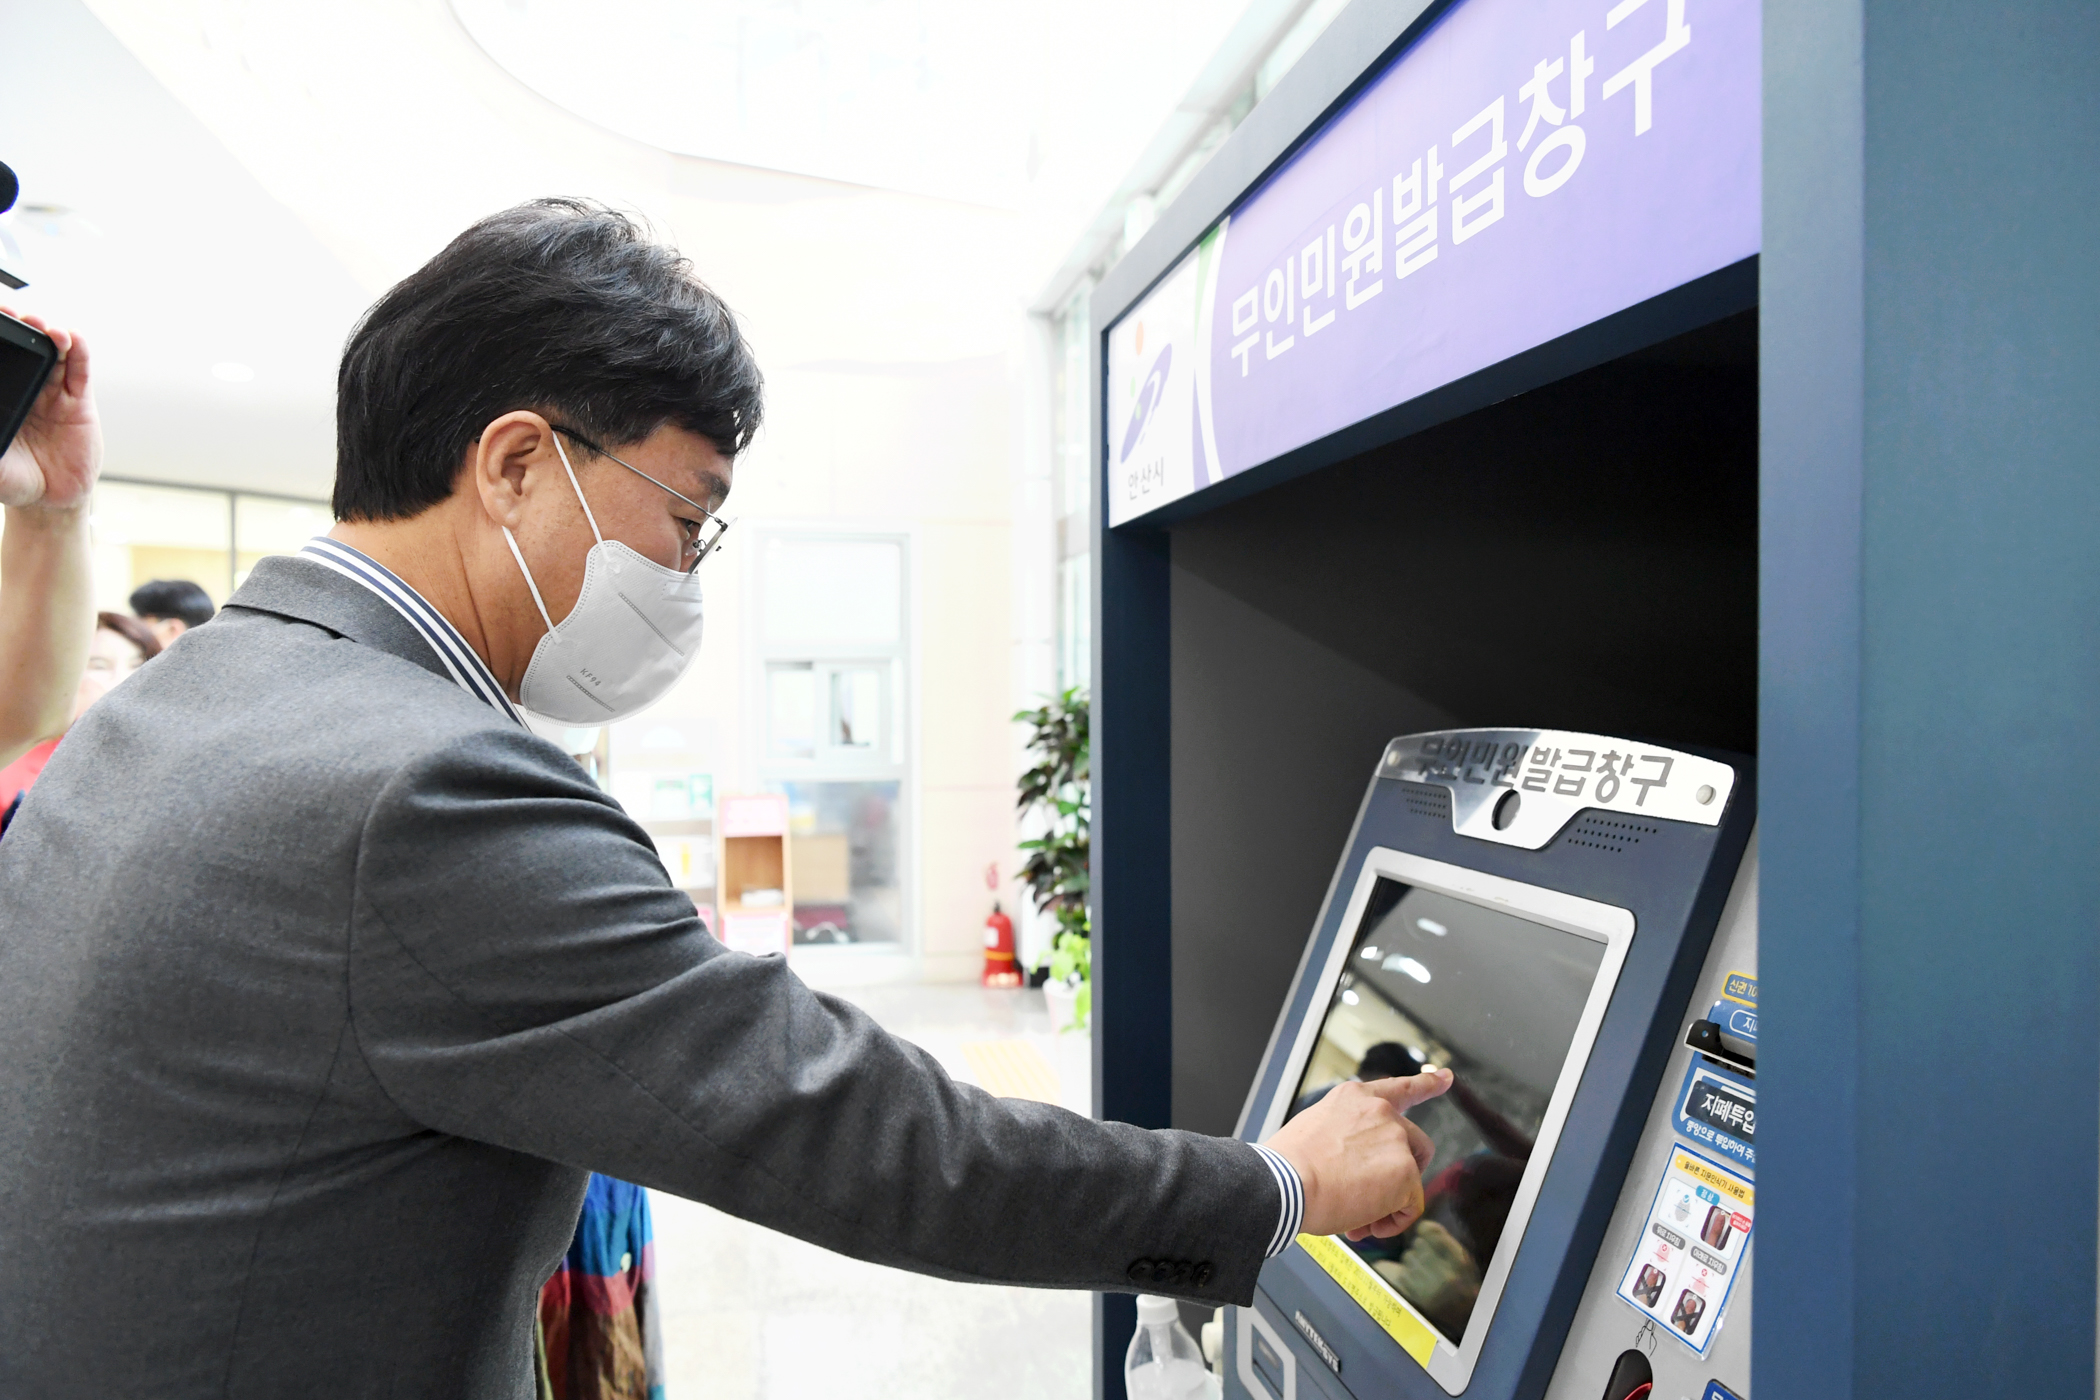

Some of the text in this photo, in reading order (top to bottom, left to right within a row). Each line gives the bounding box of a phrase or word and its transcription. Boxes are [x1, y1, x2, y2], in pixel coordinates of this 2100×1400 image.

[1231, 0, 1690, 377] 무인민원발급창구
[1128, 456, 1164, 500] 안산시
[580, 668, 601, 686] KF94
[1415, 738, 1674, 806] 무인민원발급창구
[1686, 1120, 1715, 1142] 중앙으로
[1715, 1133, 1745, 1157] 투입하여
[1684, 1161, 1745, 1199] 올바른 지문인식기 사용법
